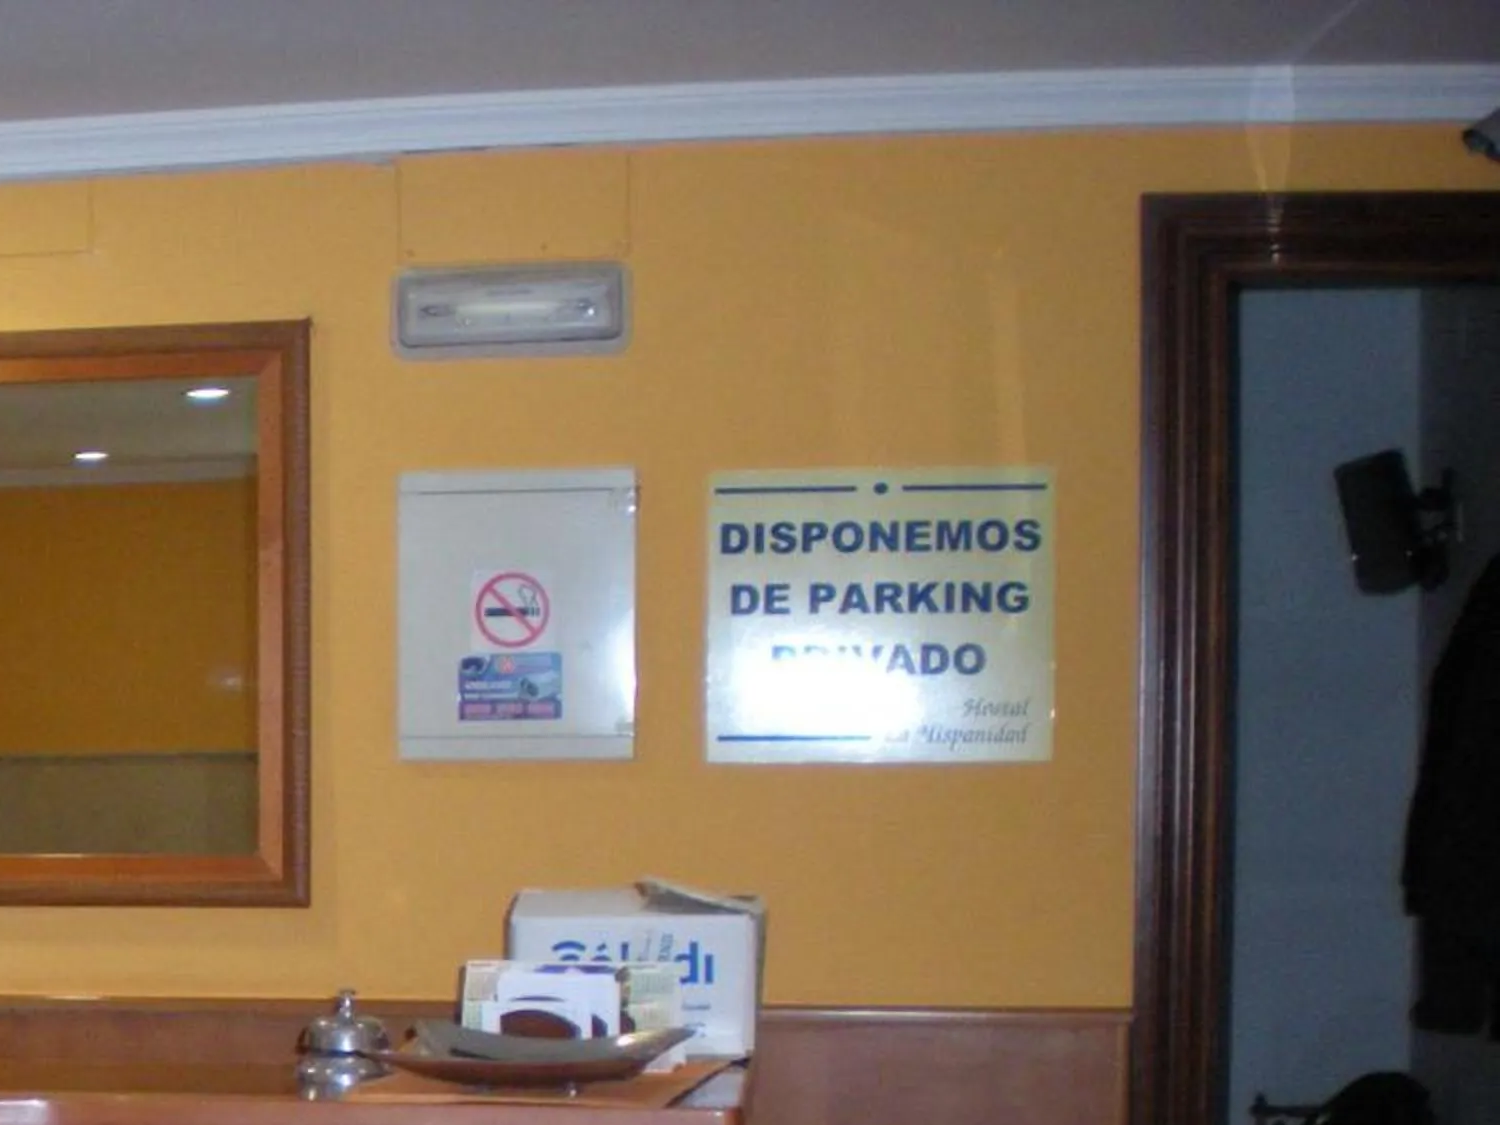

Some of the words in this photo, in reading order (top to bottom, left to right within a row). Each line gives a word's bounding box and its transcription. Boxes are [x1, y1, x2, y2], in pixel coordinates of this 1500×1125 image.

[719, 519, 1043, 555] DISPONEMOS
[730, 583, 791, 615] DE
[808, 581, 1030, 615] PARKING
